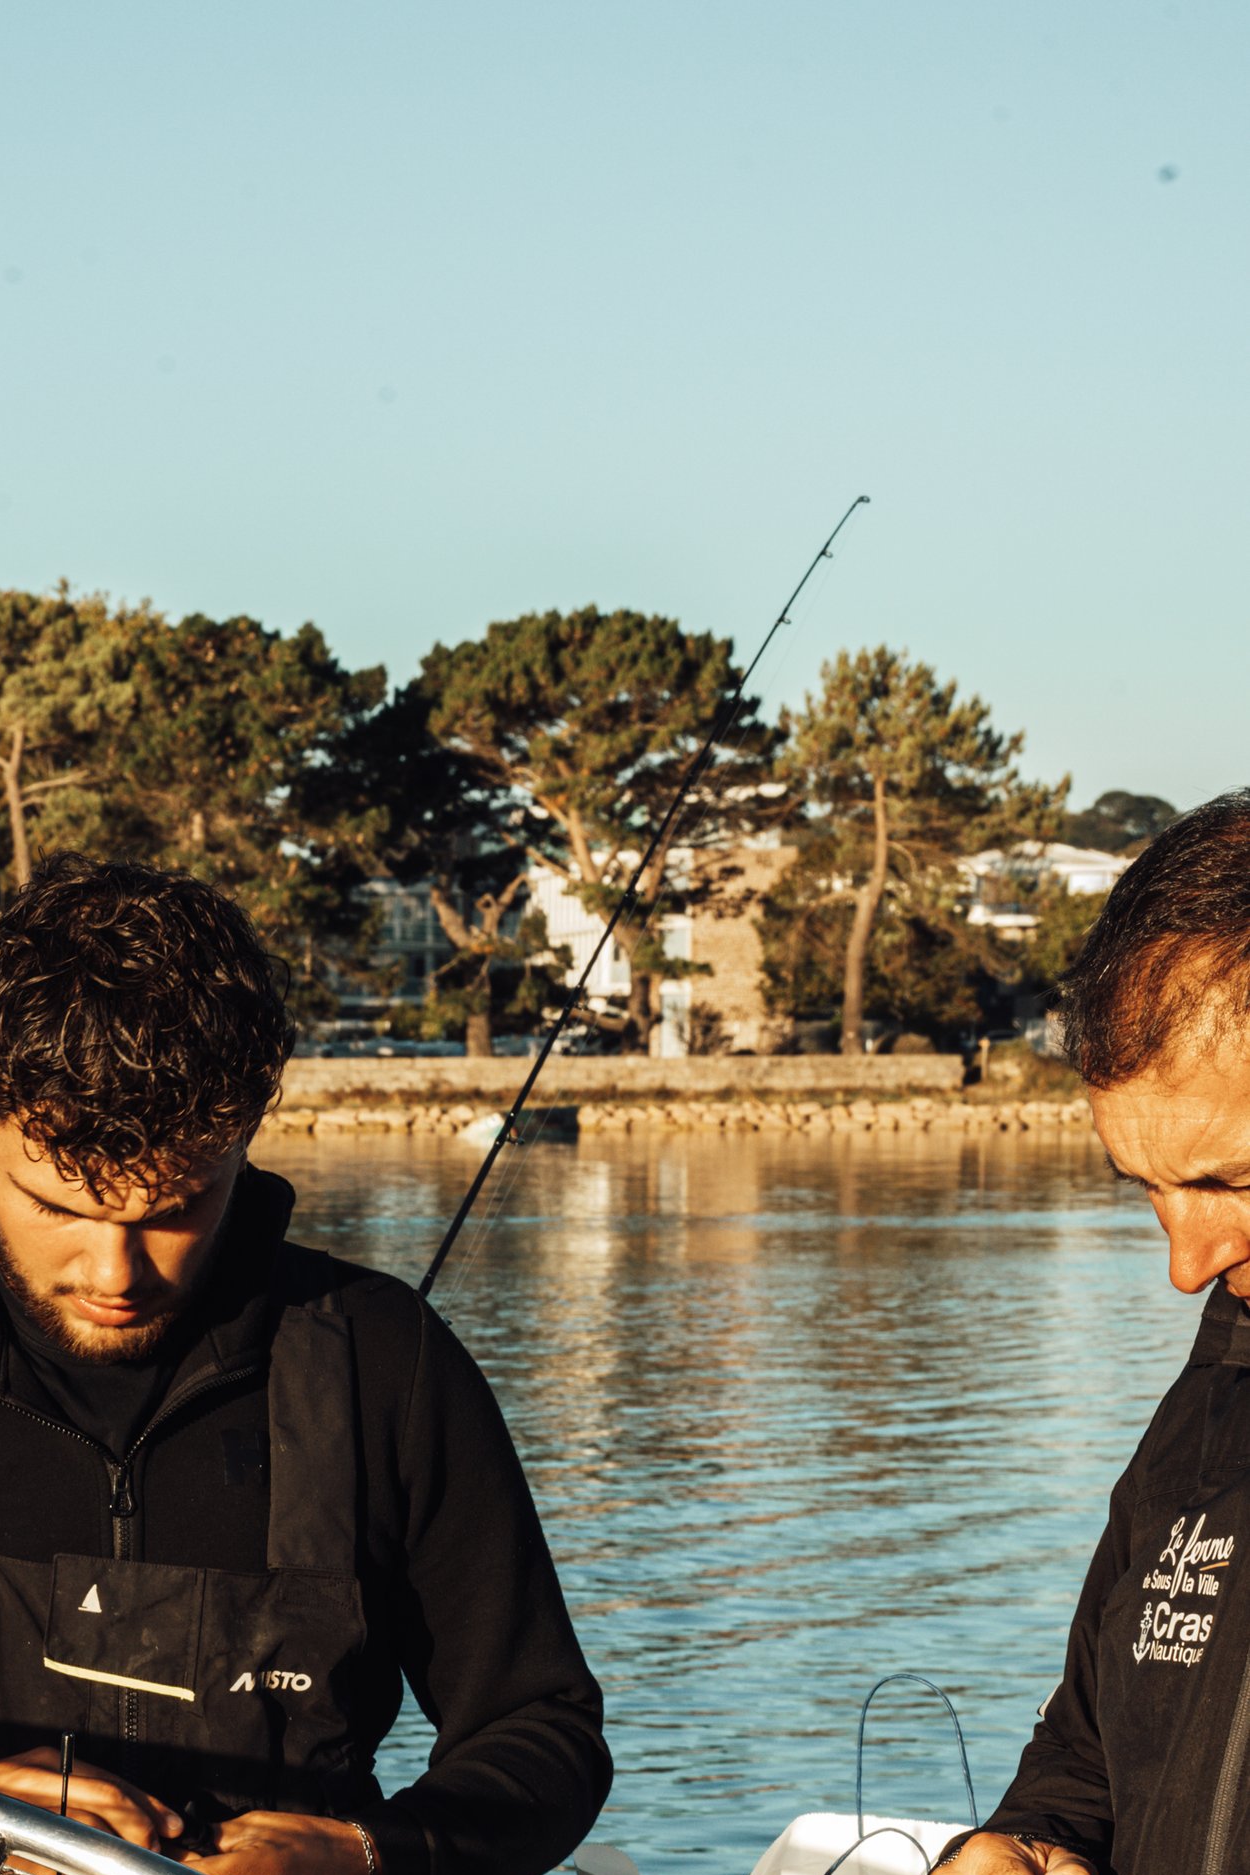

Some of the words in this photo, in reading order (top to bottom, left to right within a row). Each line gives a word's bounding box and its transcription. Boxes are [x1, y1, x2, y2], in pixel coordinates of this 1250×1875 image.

[1151, 1568, 1172, 1591] Sous
[1181, 1572, 1195, 1594] la
[1197, 1573, 1220, 1596] Ville
[1153, 1601, 1214, 1643] Cras
[1149, 1640, 1204, 1668] Nautique
